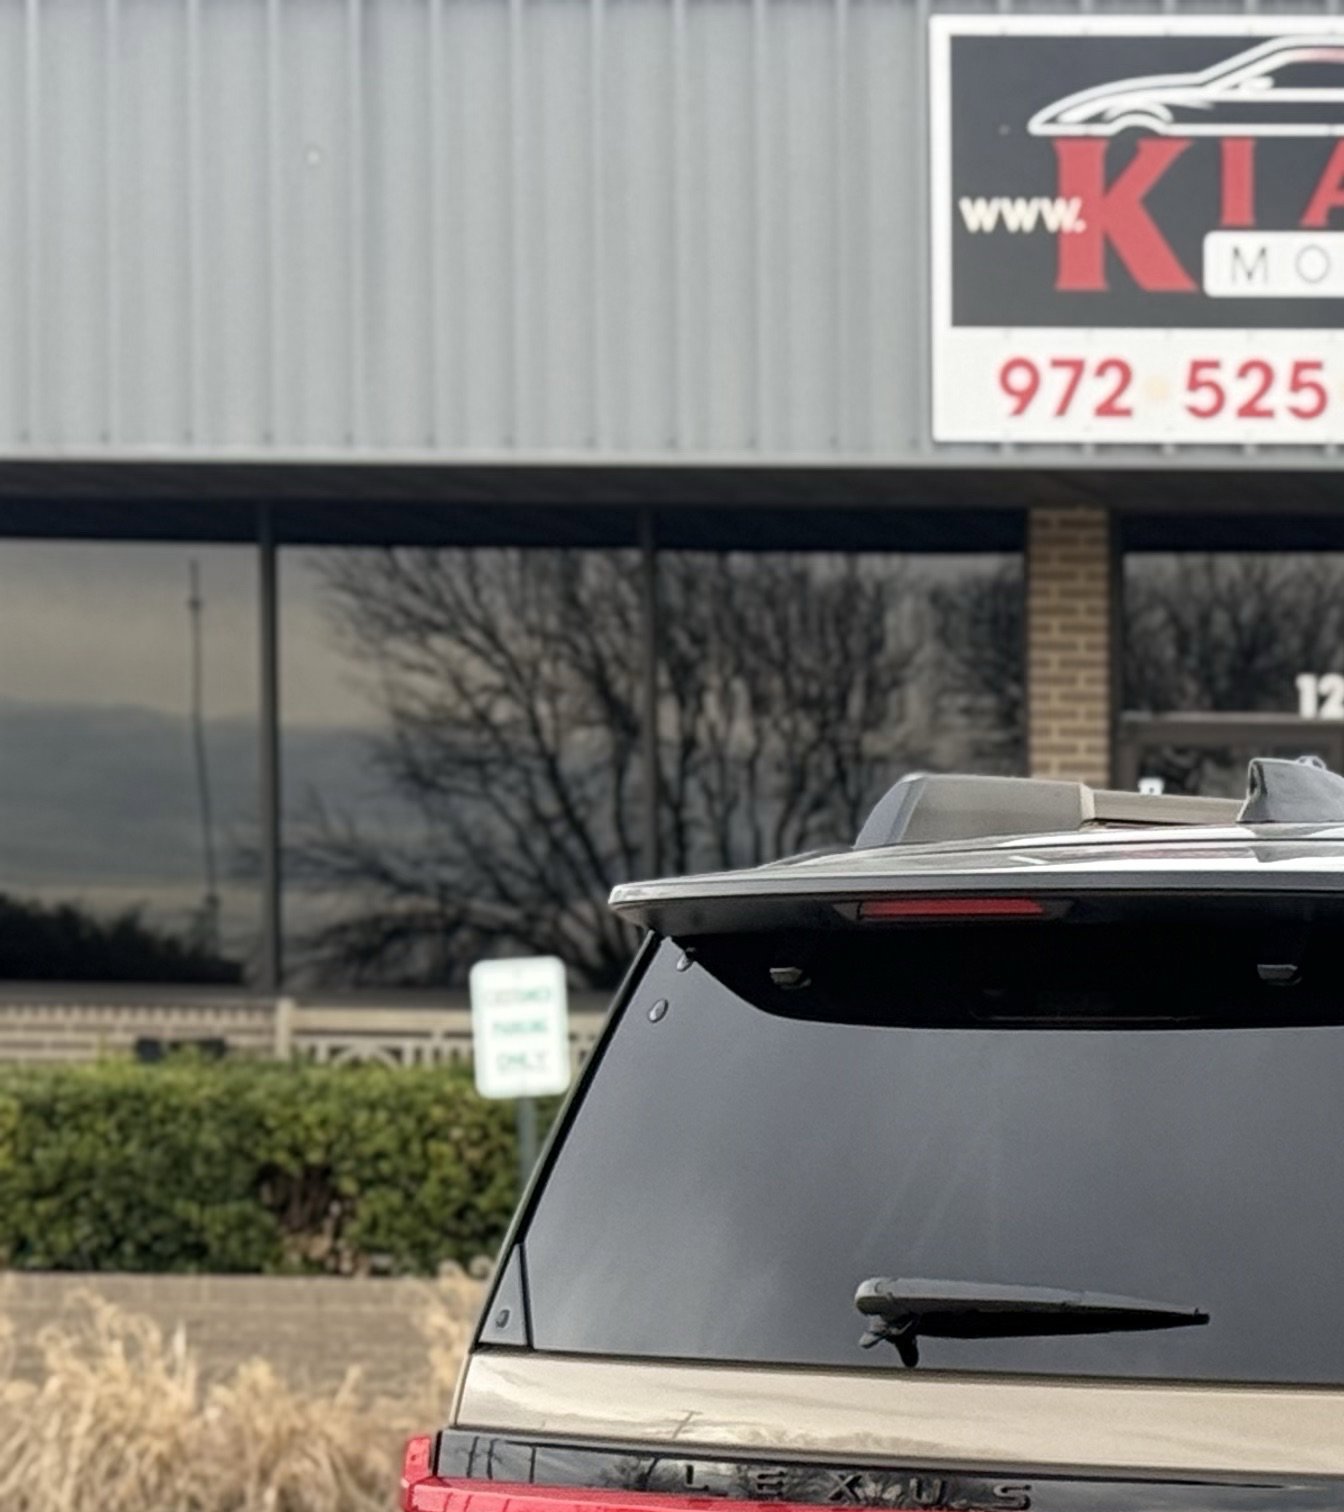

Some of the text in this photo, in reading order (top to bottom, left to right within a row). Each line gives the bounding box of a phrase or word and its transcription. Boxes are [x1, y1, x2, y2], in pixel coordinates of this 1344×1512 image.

[959, 197, 1087, 233] www.
[1000, 358, 1134, 420] 972
[1183, 358, 1328, 420] 525
[682, 1463, 1032, 1512] LEXUS
